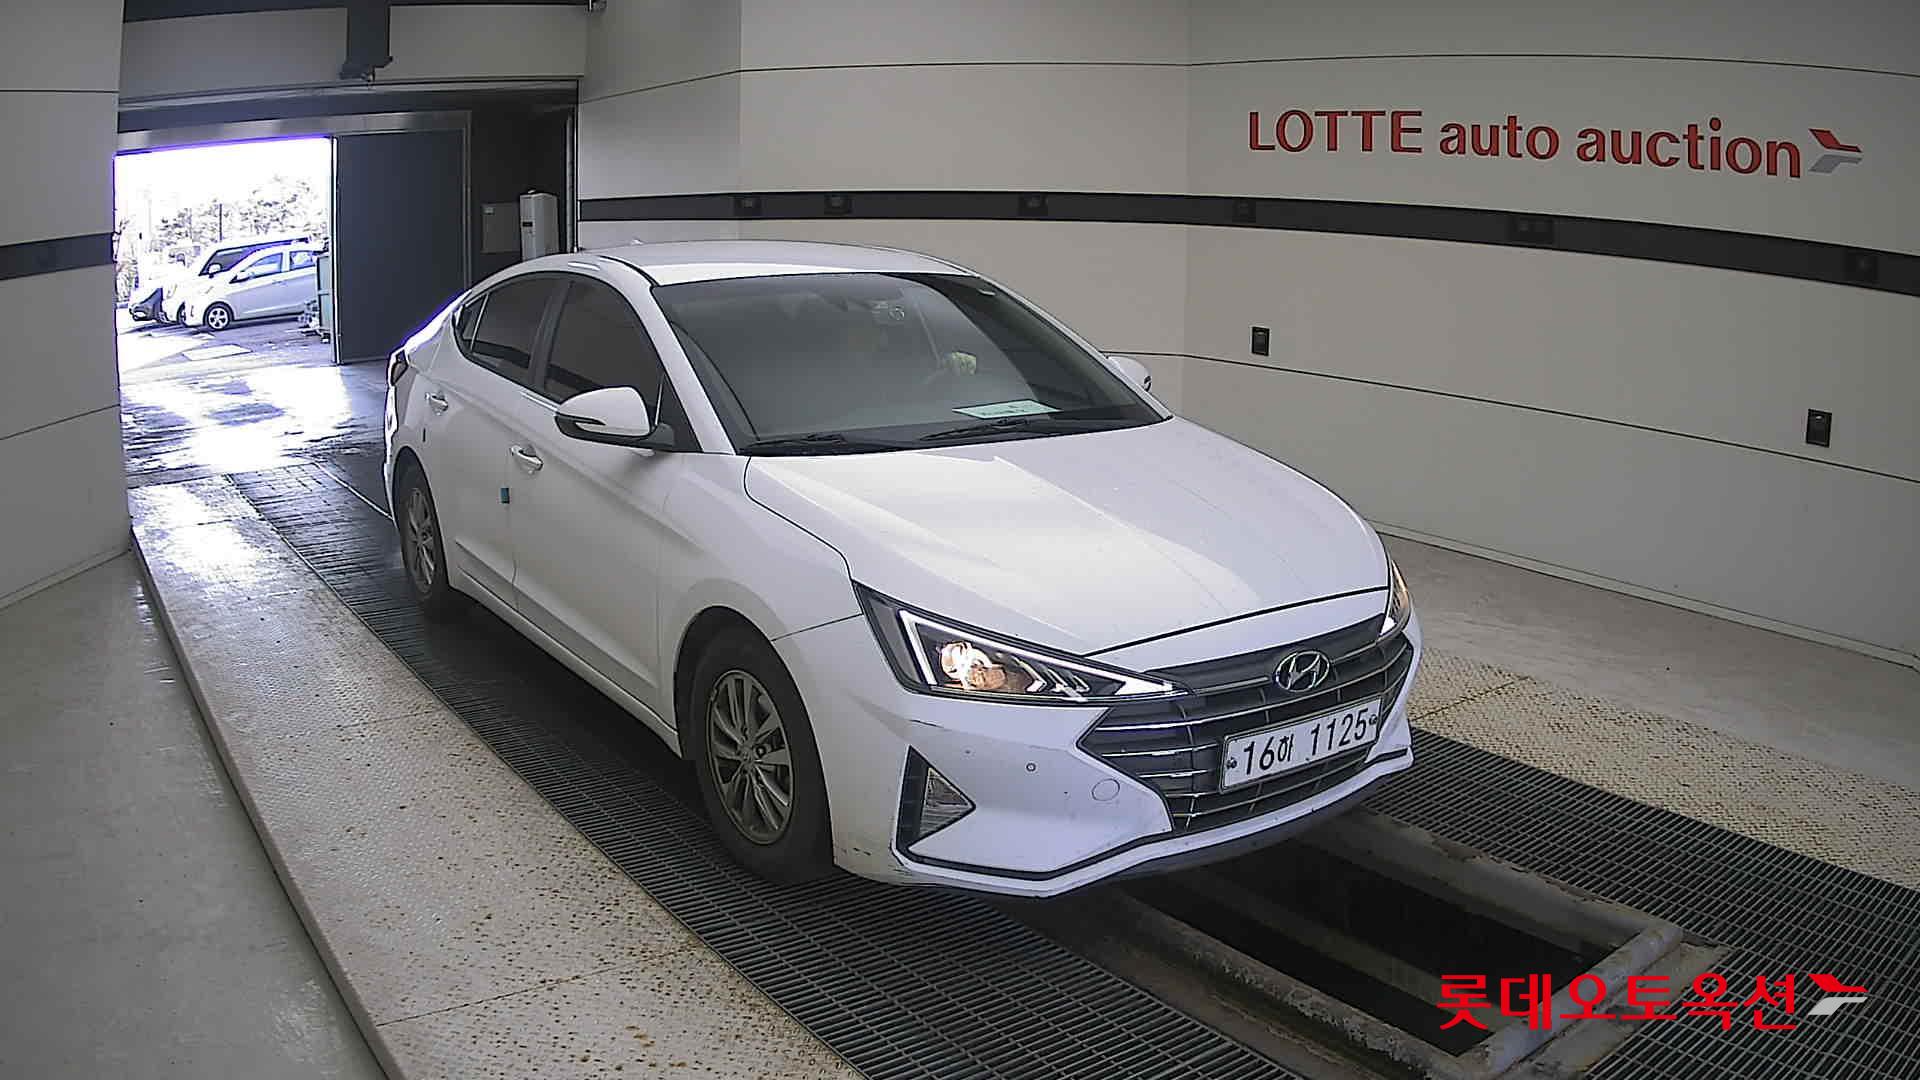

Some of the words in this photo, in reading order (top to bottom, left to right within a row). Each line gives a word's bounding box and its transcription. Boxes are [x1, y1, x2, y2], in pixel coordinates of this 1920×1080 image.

[1249, 111, 1423, 153] LOTTE
[1439, 116, 1559, 158] auto
[1576, 118, 1800, 177] auction
[1243, 734, 1294, 775] 16하
[1311, 708, 1369, 756] 1125
